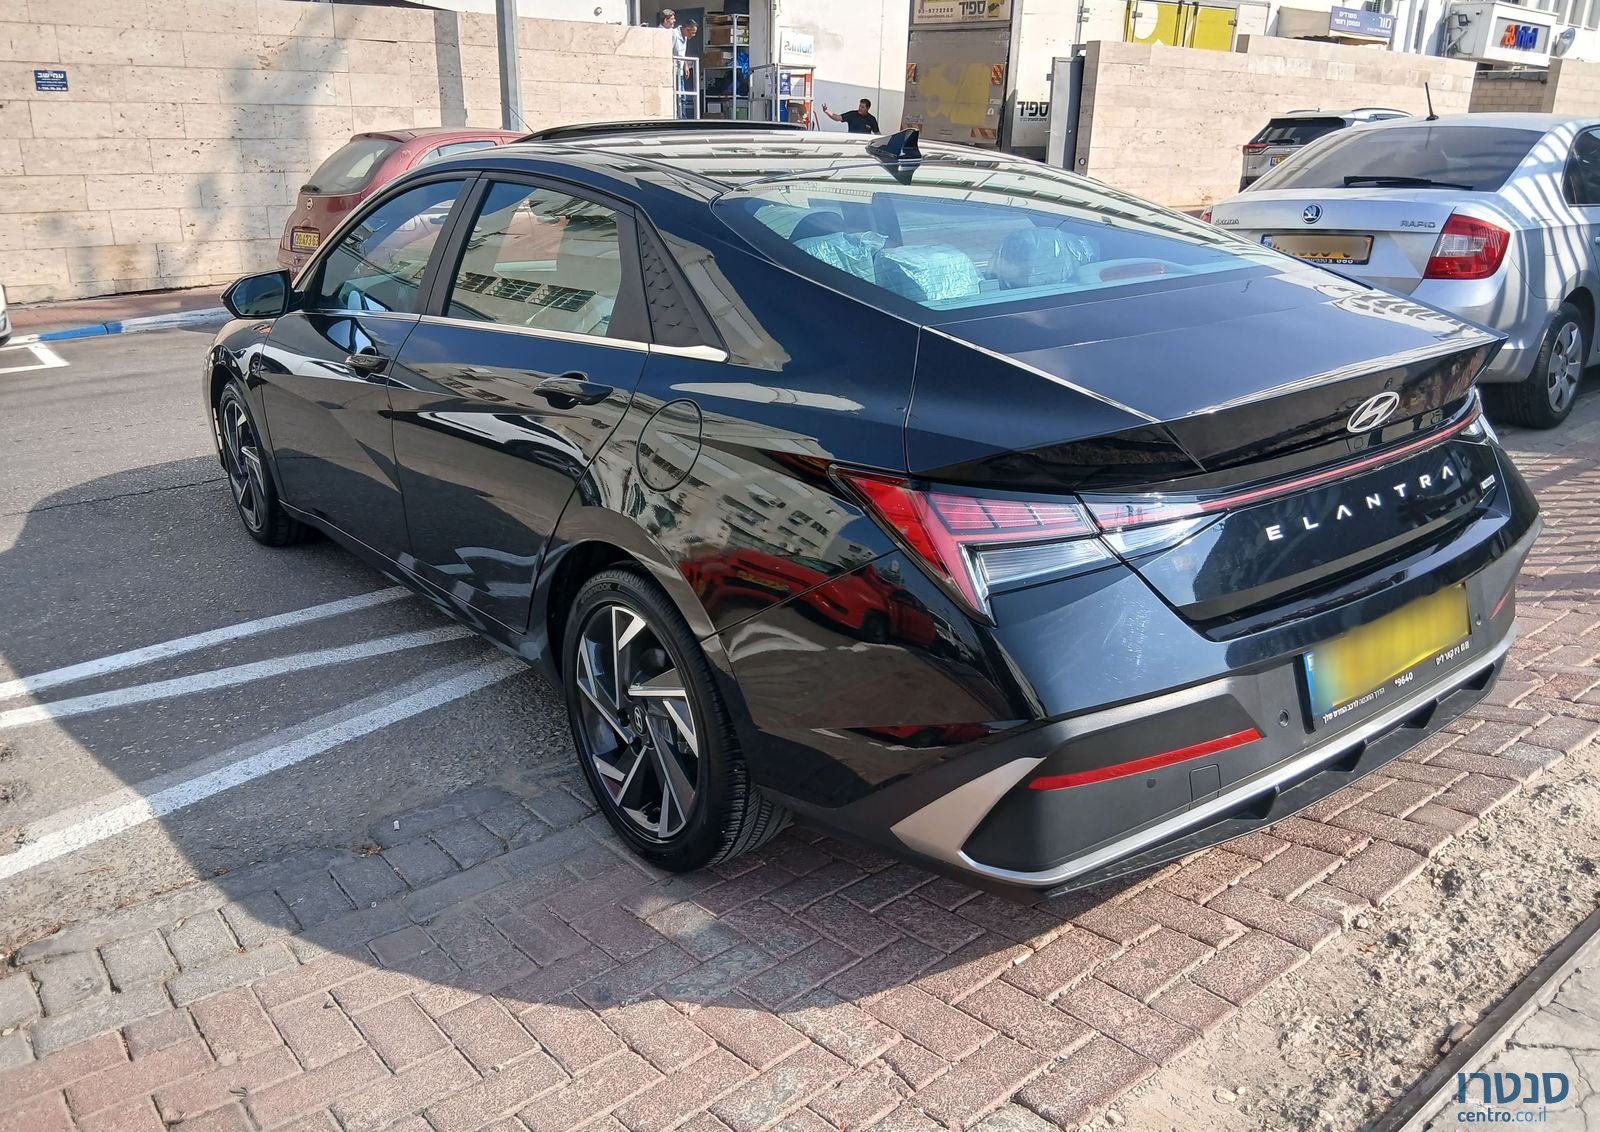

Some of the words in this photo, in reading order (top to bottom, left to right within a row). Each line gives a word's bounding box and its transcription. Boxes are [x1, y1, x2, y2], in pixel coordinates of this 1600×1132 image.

[958, 1, 986, 16] ספיד
[1378, 16, 1392, 29] מור
[1017, 101, 1050, 117] ספיד
[1400, 220, 1436, 228] RAPID
[1265, 465, 1454, 541] ELANTRA
